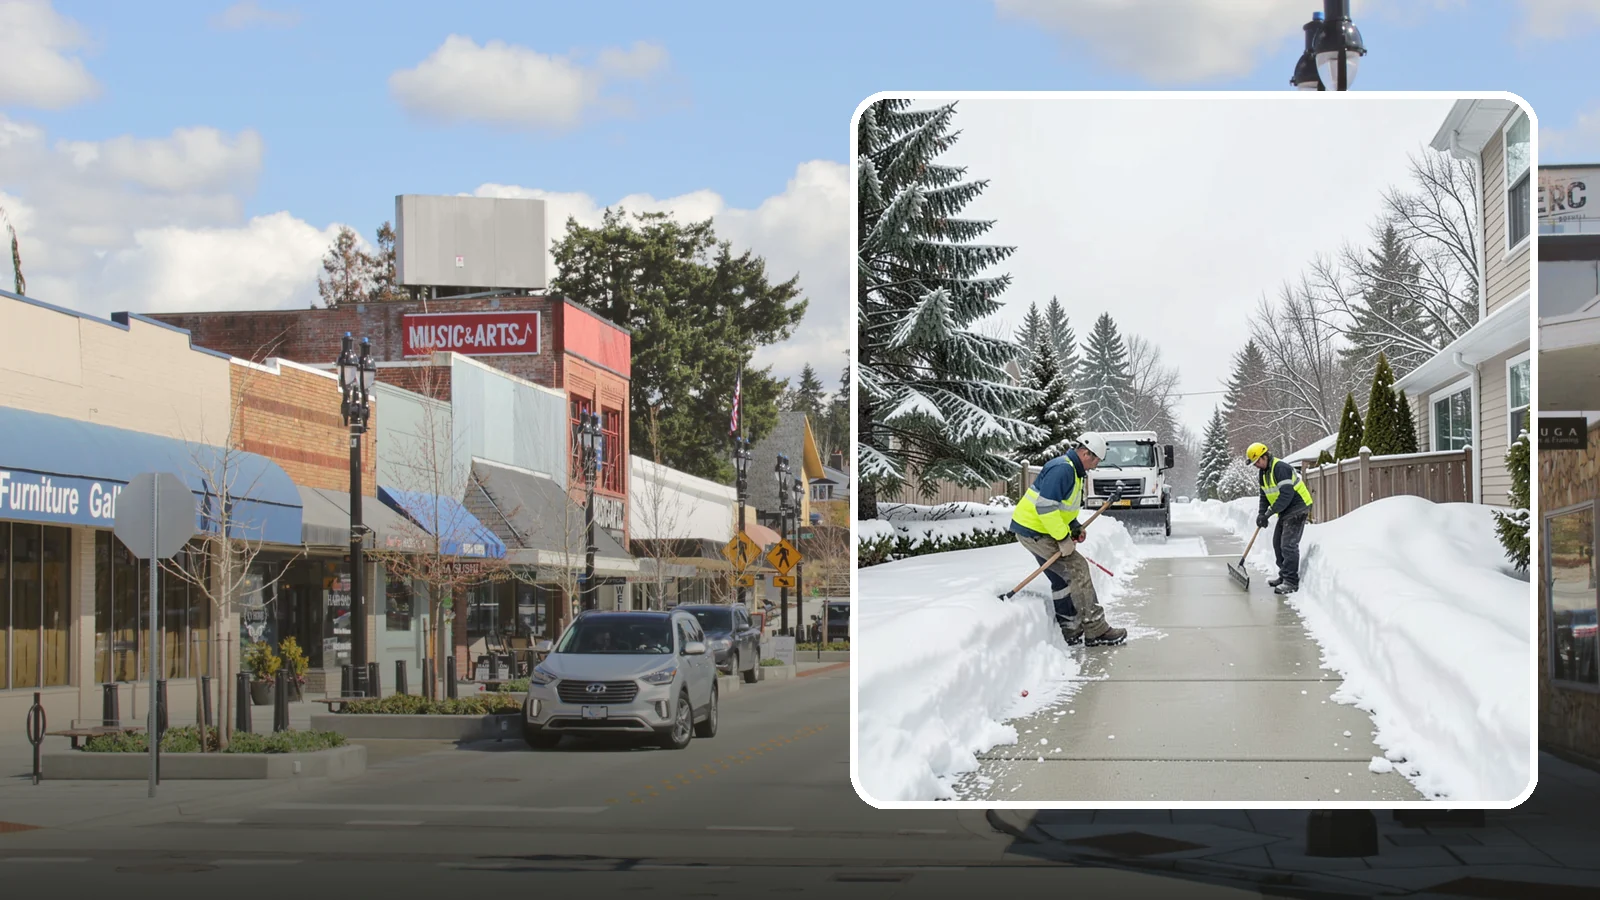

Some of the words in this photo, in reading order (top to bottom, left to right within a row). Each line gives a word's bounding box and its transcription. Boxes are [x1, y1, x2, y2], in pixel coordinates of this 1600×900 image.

[0, 471, 79, 515] Furniture
[89, 482, 122, 519] Gal
[453, 563, 478, 574] SUSHI
